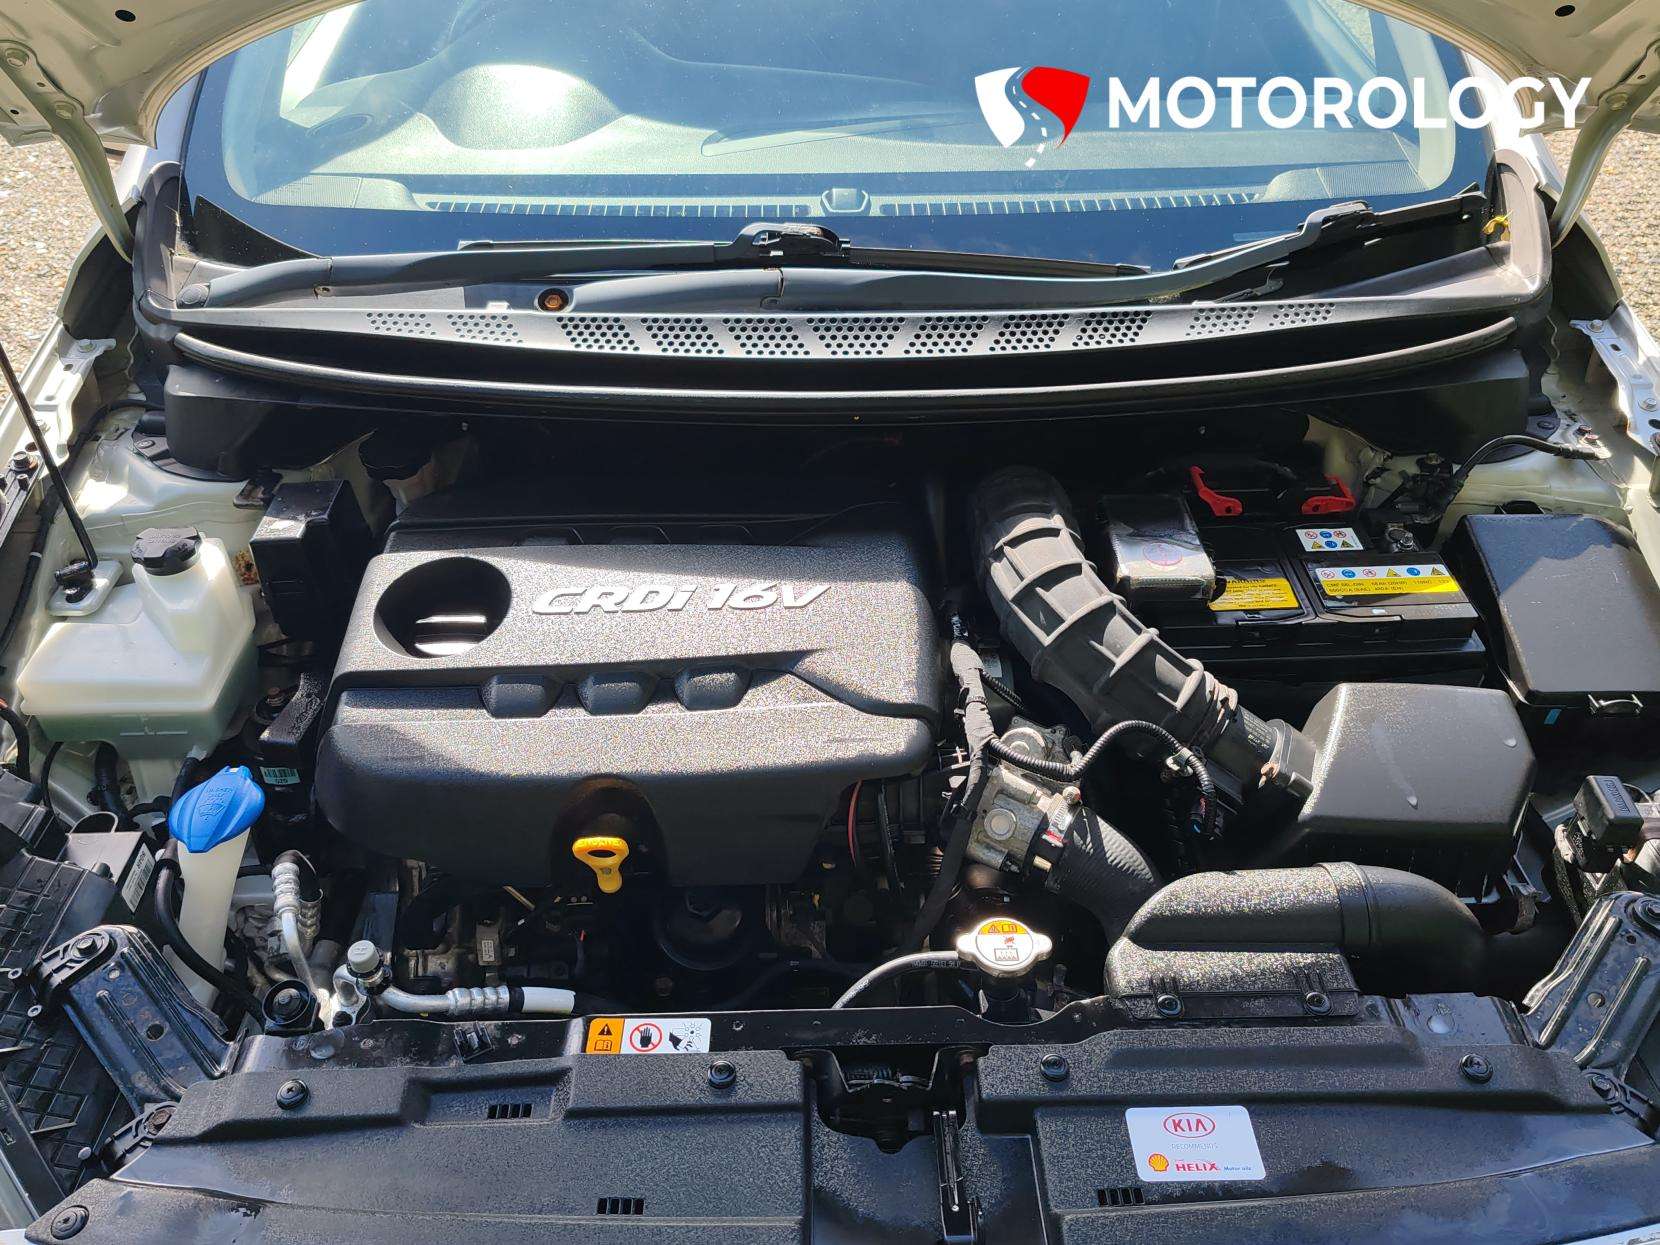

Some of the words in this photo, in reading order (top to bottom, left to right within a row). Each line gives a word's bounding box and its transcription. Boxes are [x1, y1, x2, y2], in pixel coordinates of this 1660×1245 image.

[533, 585, 698, 614] CRDi
[707, 582, 832, 610] 16V
[1171, 1118, 1208, 1132] KIA
[1175, 1162, 1219, 1171] HELIX
